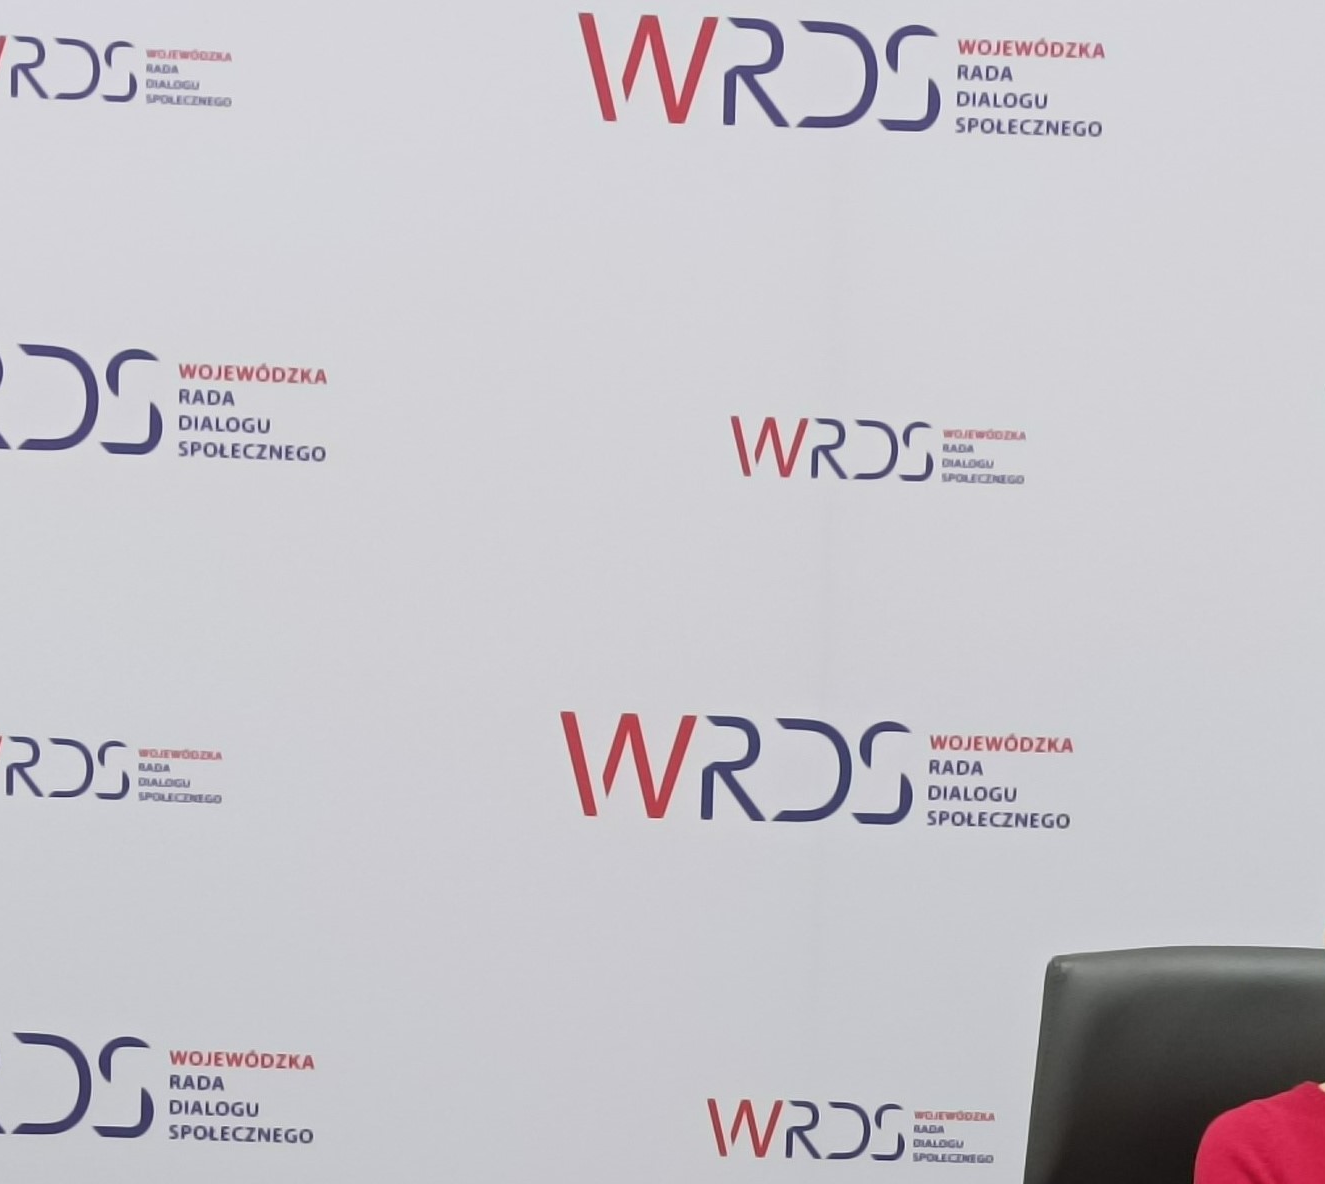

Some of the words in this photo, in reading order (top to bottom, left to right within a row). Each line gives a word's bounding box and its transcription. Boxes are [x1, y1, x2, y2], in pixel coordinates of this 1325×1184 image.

[958, 38, 1105, 58] WOJEWÓDZKA
[579, 13, 940, 132] WRDS
[957, 65, 1012, 81] RADA
[957, 91, 1047, 109] DIALOGU
[956, 117, 1102, 137] SPOŁECZNEGO
[179, 364, 327, 384] WOJEWÓDZKA
[179, 389, 234, 406] RADA
[179, 415, 270, 434] DIALOGU
[179, 441, 326, 462] SPOŁECZNEGO
[731, 416, 933, 481] WRDS
[930, 734, 1073, 753] WOJEWÓDZKA
[561, 711, 913, 825] WRDS
[929, 760, 983, 775] RADA
[928, 785, 1017, 802] DIALOGU
[928, 811, 1070, 829] SPOŁECZNEGO
[170, 1050, 314, 1069] WOJEWÓDZKA
[170, 1075, 224, 1090] RADA
[170, 1100, 258, 1117] DIALOGU
[169, 1125, 313, 1143] SPOŁECZNEGO
[707, 1099, 905, 1161] WRDS
